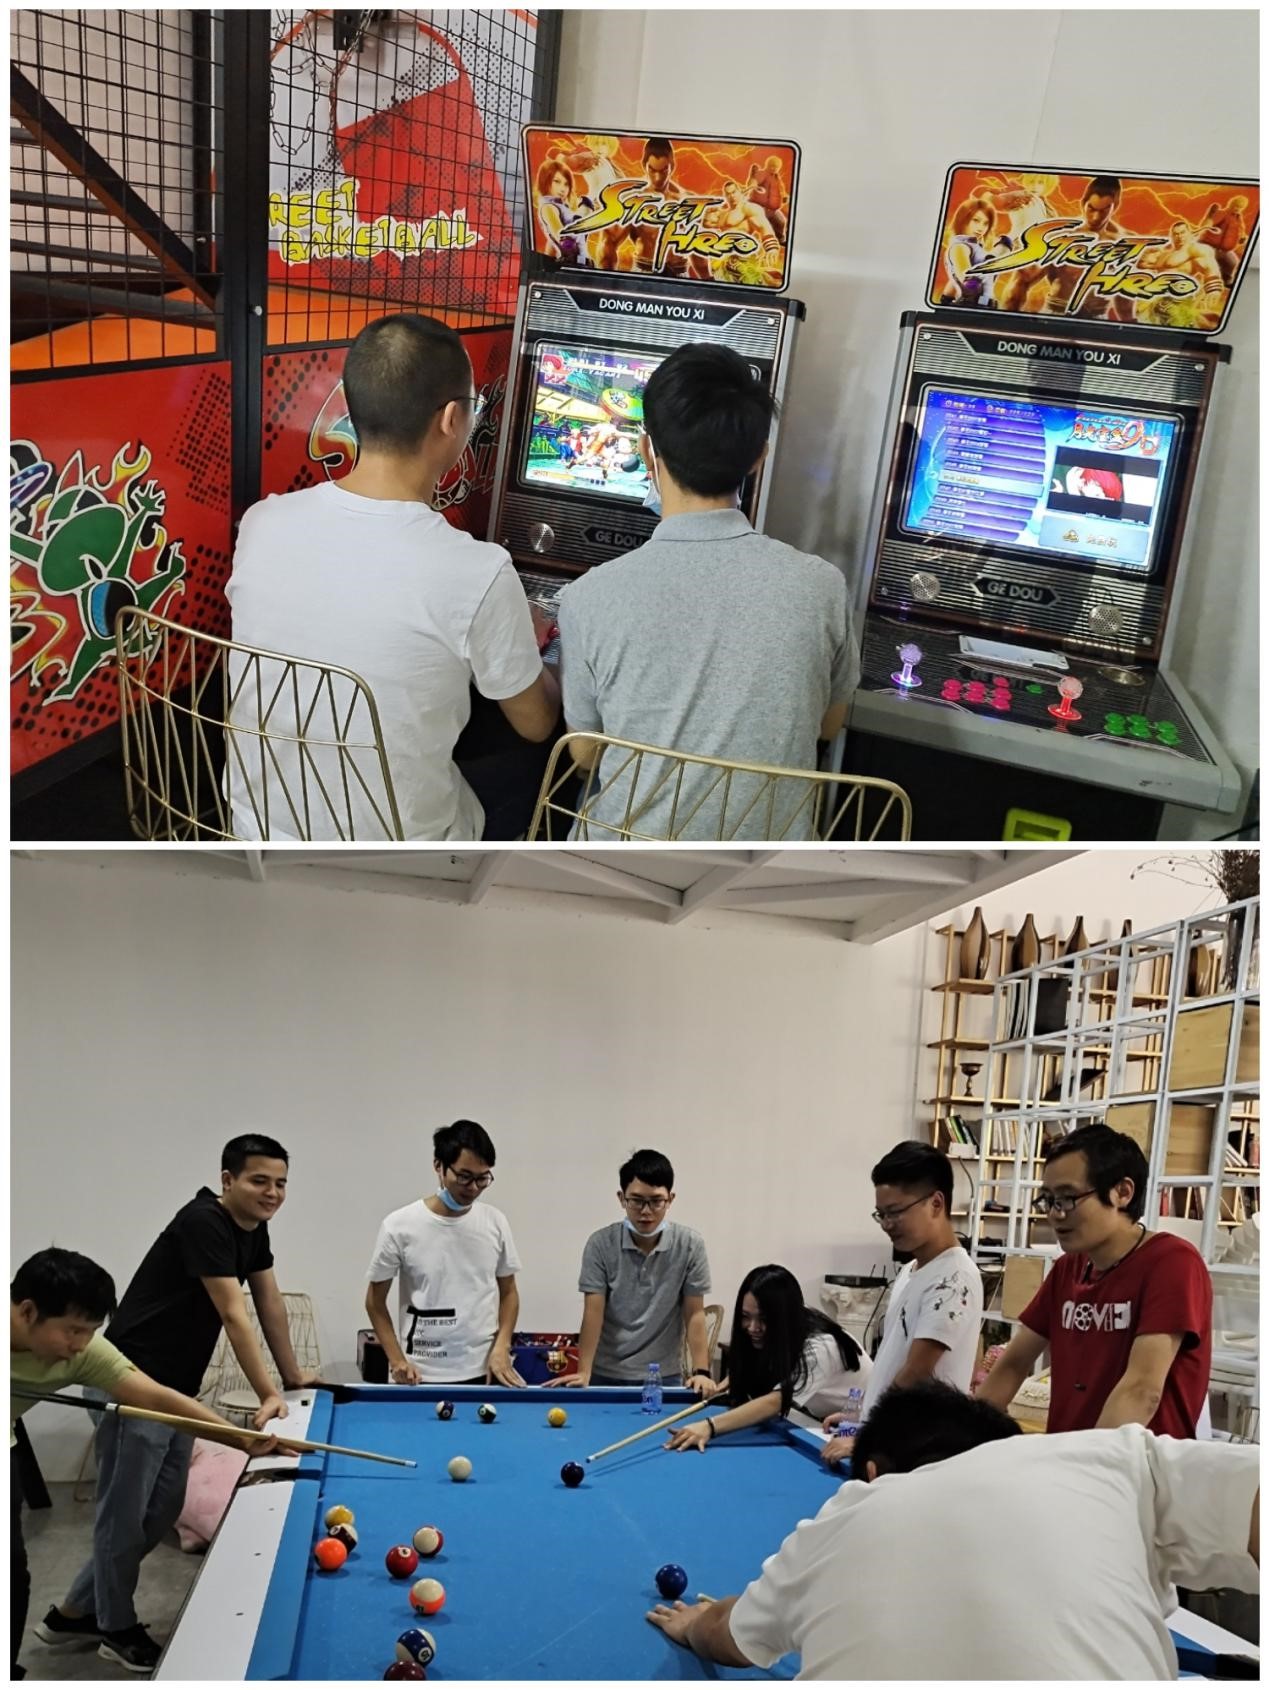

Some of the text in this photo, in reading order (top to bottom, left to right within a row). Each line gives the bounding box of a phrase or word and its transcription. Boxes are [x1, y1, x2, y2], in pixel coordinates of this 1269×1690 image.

[560, 181, 724, 234] STREET
[281, 216, 475, 262] BASKETBALL
[965, 218, 1168, 274] STREET
[599, 298, 705, 320] DONG MAN YOU XI
[997, 341, 1121, 365] DONG MAN YOU XI
[595, 530, 612, 543] GE
[987, 581, 1043, 601] GE DOU
[414, 1339, 442, 1347] SERVICE
[414, 1350, 447, 1358] PROVIDER
